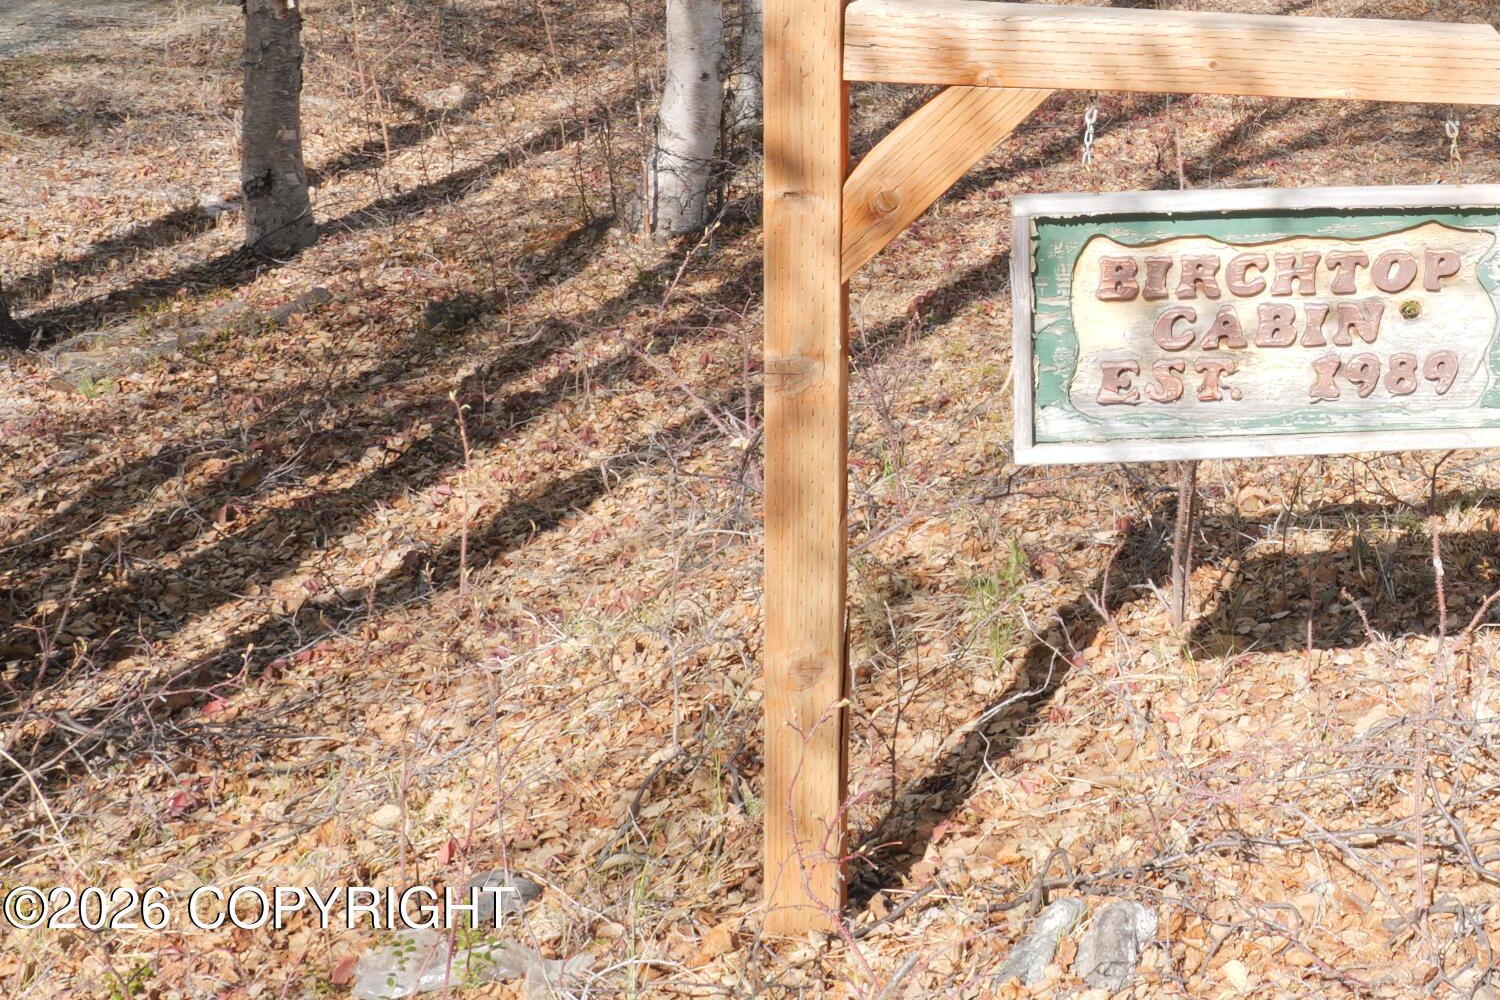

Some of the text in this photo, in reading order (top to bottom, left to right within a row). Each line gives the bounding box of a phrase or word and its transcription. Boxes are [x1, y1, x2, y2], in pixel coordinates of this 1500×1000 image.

[1096, 250, 1462, 300] BIRCHTOP
[1153, 302, 1386, 351] CABIN
[1096, 351, 1459, 405] EST. 1989
